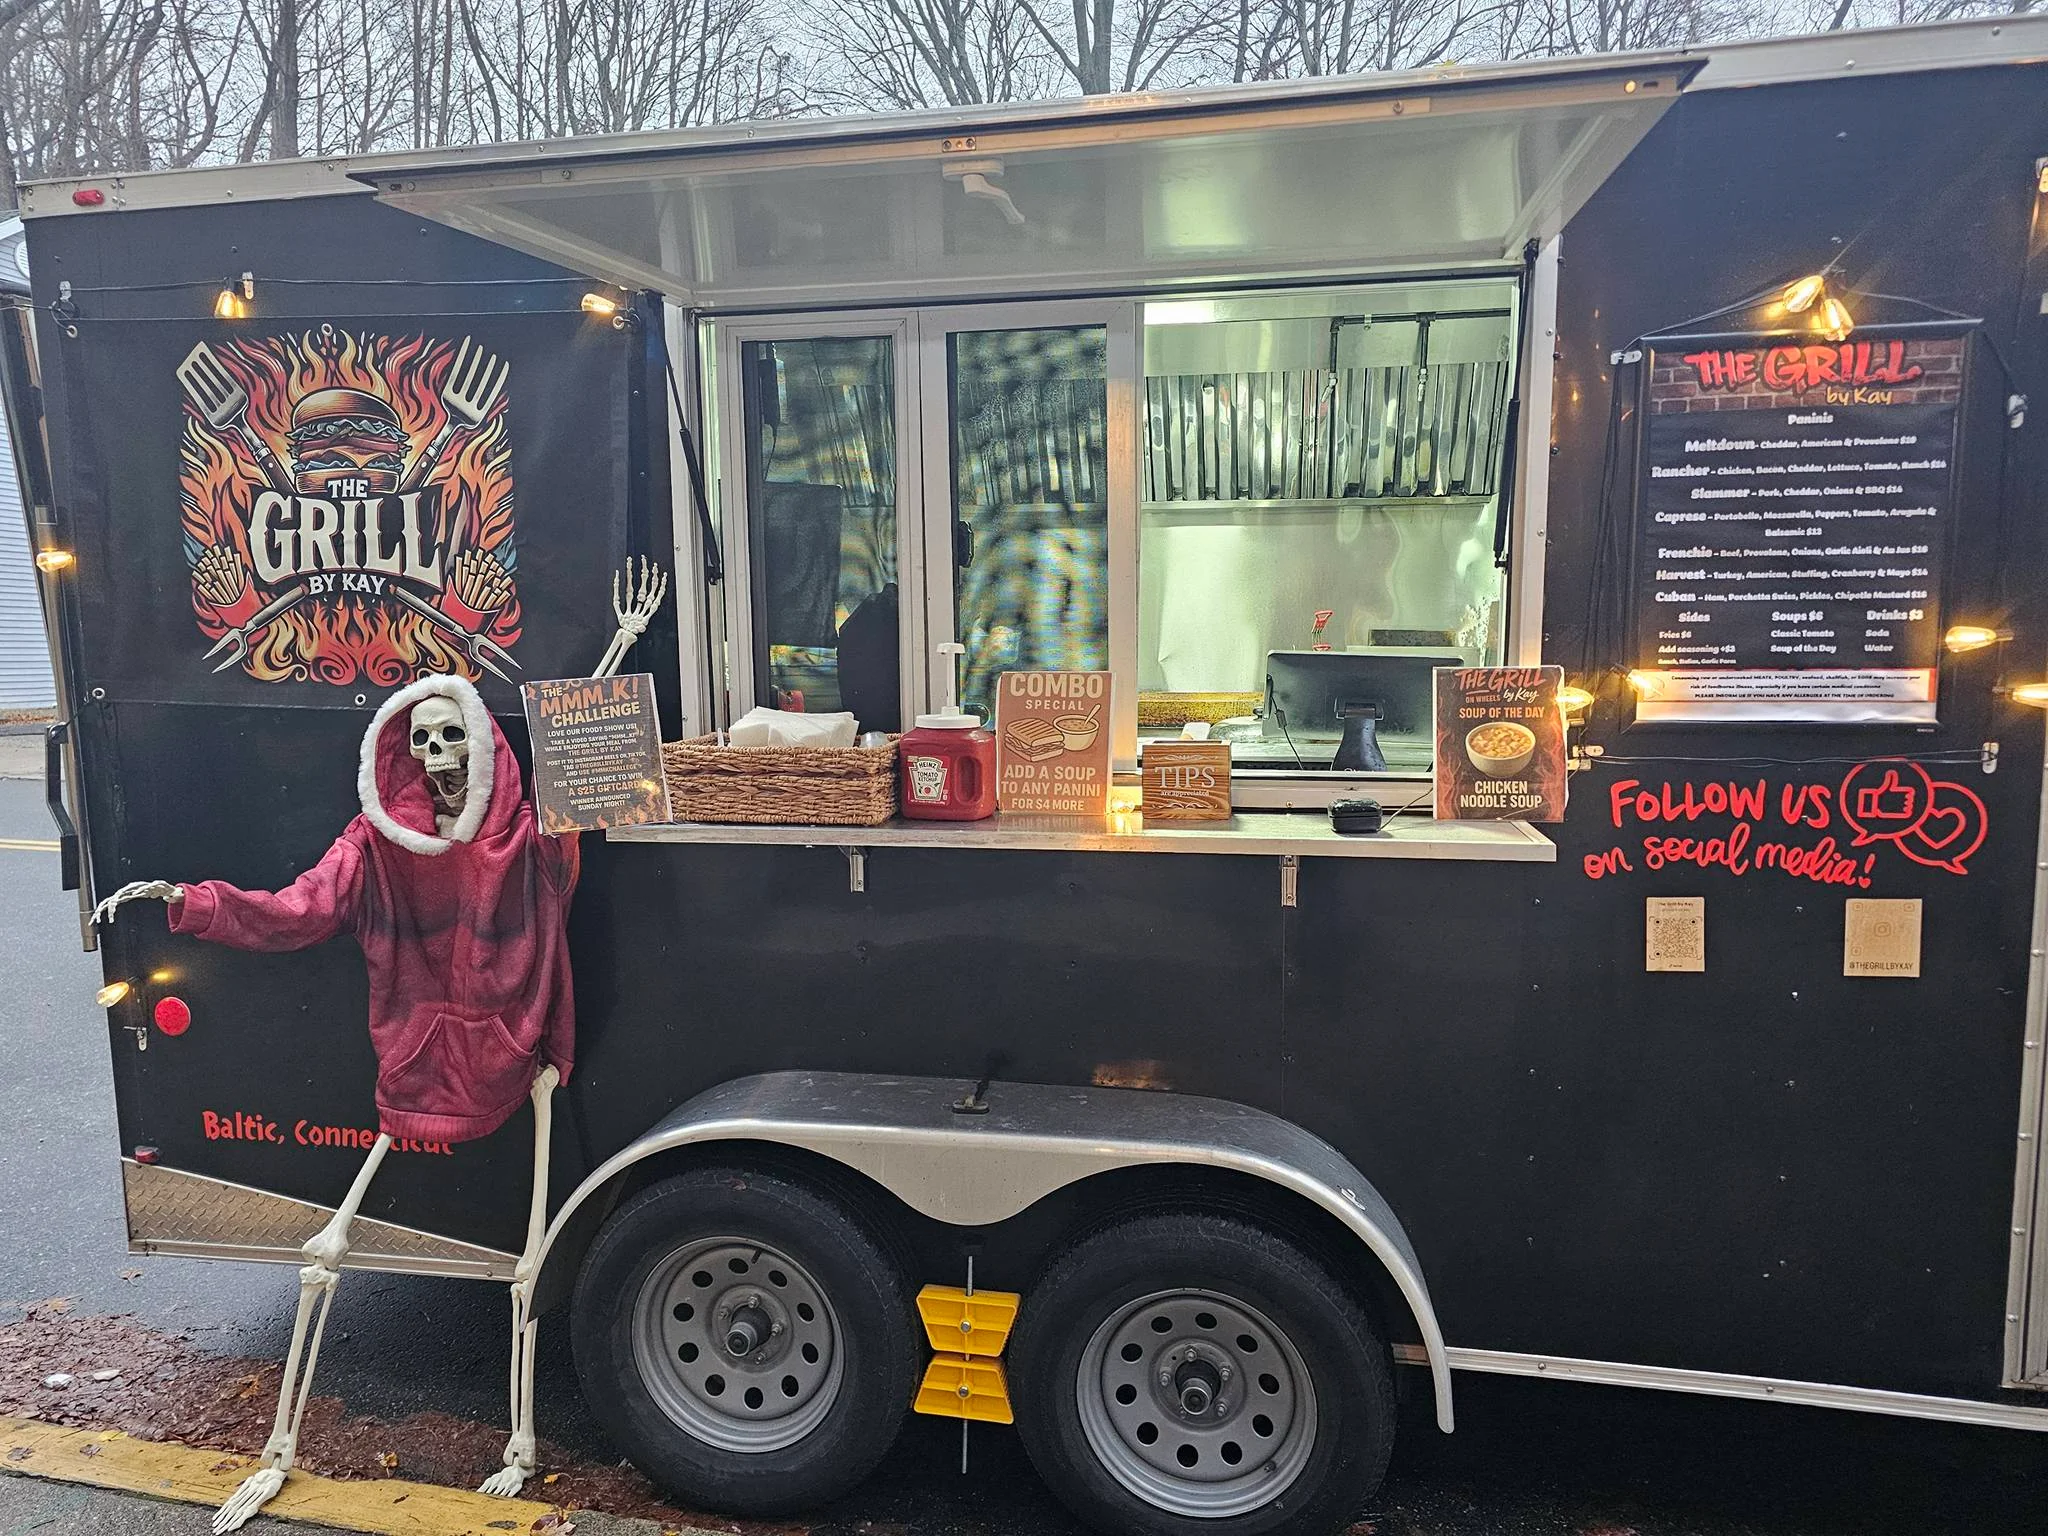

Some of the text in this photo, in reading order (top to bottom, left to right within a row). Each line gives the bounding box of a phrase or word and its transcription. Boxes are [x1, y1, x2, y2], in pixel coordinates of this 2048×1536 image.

[1683, 340, 1924, 395] THE GRILL
[1826, 386, 1893, 405] by Kay
[1788, 412, 1833, 425] Paninis
[1801, 438, 1842, 447] American
[1854, 437, 1899, 446] Provolone
[1652, 464, 1710, 477] Rancher
[1717, 466, 1755, 475] Chicken,
[327, 479, 369, 498] THE
[1691, 488, 1750, 499] Slammer
[1823, 486, 1853, 495] Onions
[1655, 512, 1706, 524] Caprese
[1765, 528, 1805, 536] Balsamic
[247, 490, 444, 588] GRILL
[1658, 545, 1712, 558] Frenchie
[1825, 546, 1851, 555] Garlic
[1656, 569, 1706, 580] Harvest
[1713, 571, 1745, 580] Turkey,
[1746, 570, 1790, 579] American,
[1791, 569, 1830, 579] Stuffing,
[1831, 569, 1876, 578] Cranberry
[1887, 568, 1911, 578] Mayo
[309, 574, 387, 595] BY KAY
[1655, 590, 1696, 602] Cuban
[1704, 594, 1728, 602] Ham,
[1772, 592, 1799, 601] Swiss,
[1800, 591, 1833, 600] Pickles,
[1834, 591, 1872, 601] Chipotle
[1873, 591, 1911, 599] Mustard
[1678, 611, 1711, 622] Sides
[1772, 611, 1807, 623] Soups
[1866, 609, 1908, 620] Drinks
[1659, 630, 1680, 639] Fries
[1770, 629, 1835, 638] Classic Tomato
[1865, 629, 1890, 637] Soda
[1658, 645, 1677, 653] Add
[1677, 644, 1719, 654] seasoning
[1770, 644, 1837, 654] Soup of the Day
[1864, 644, 1894, 652] Water
[1010, 673, 1104, 699] COMBO
[1455, 669, 1488, 691] THE
[541, 686, 563, 699] THE
[1475, 694, 1500, 703] WHEELS
[1503, 687, 1539, 703] by Kay
[1025, 700, 1085, 711] SPECIAL
[551, 702, 641, 728] CHALLENGE
[1459, 706, 1545, 719] SOUP OF THE DAY
[547, 729, 565, 737] LOVE
[581, 726, 603, 734] FOOD?
[604, 724, 625, 732] SHOW
[1004, 764, 1096, 781] ADD A SOUP
[1154, 766, 1216, 788] TIPS
[554, 772, 643, 788] FOR YOUR CHANCE TO WIN
[568, 780, 641, 796] A $25 GIFTCARD
[1001, 781, 1100, 797] TO ANY PANINI
[1474, 781, 1528, 794] CHICKEN
[569, 793, 631, 805] WINNER ANNOUNCED
[1012, 798, 1085, 811] FOR $4 MORE
[1460, 795, 1543, 808] NOODLE SOUP
[1781, 782, 1832, 829] US
[578, 802, 603, 811] SUNDAY
[1583, 822, 1876, 889] on social media!
[202, 1110, 287, 1145] Baltic,
